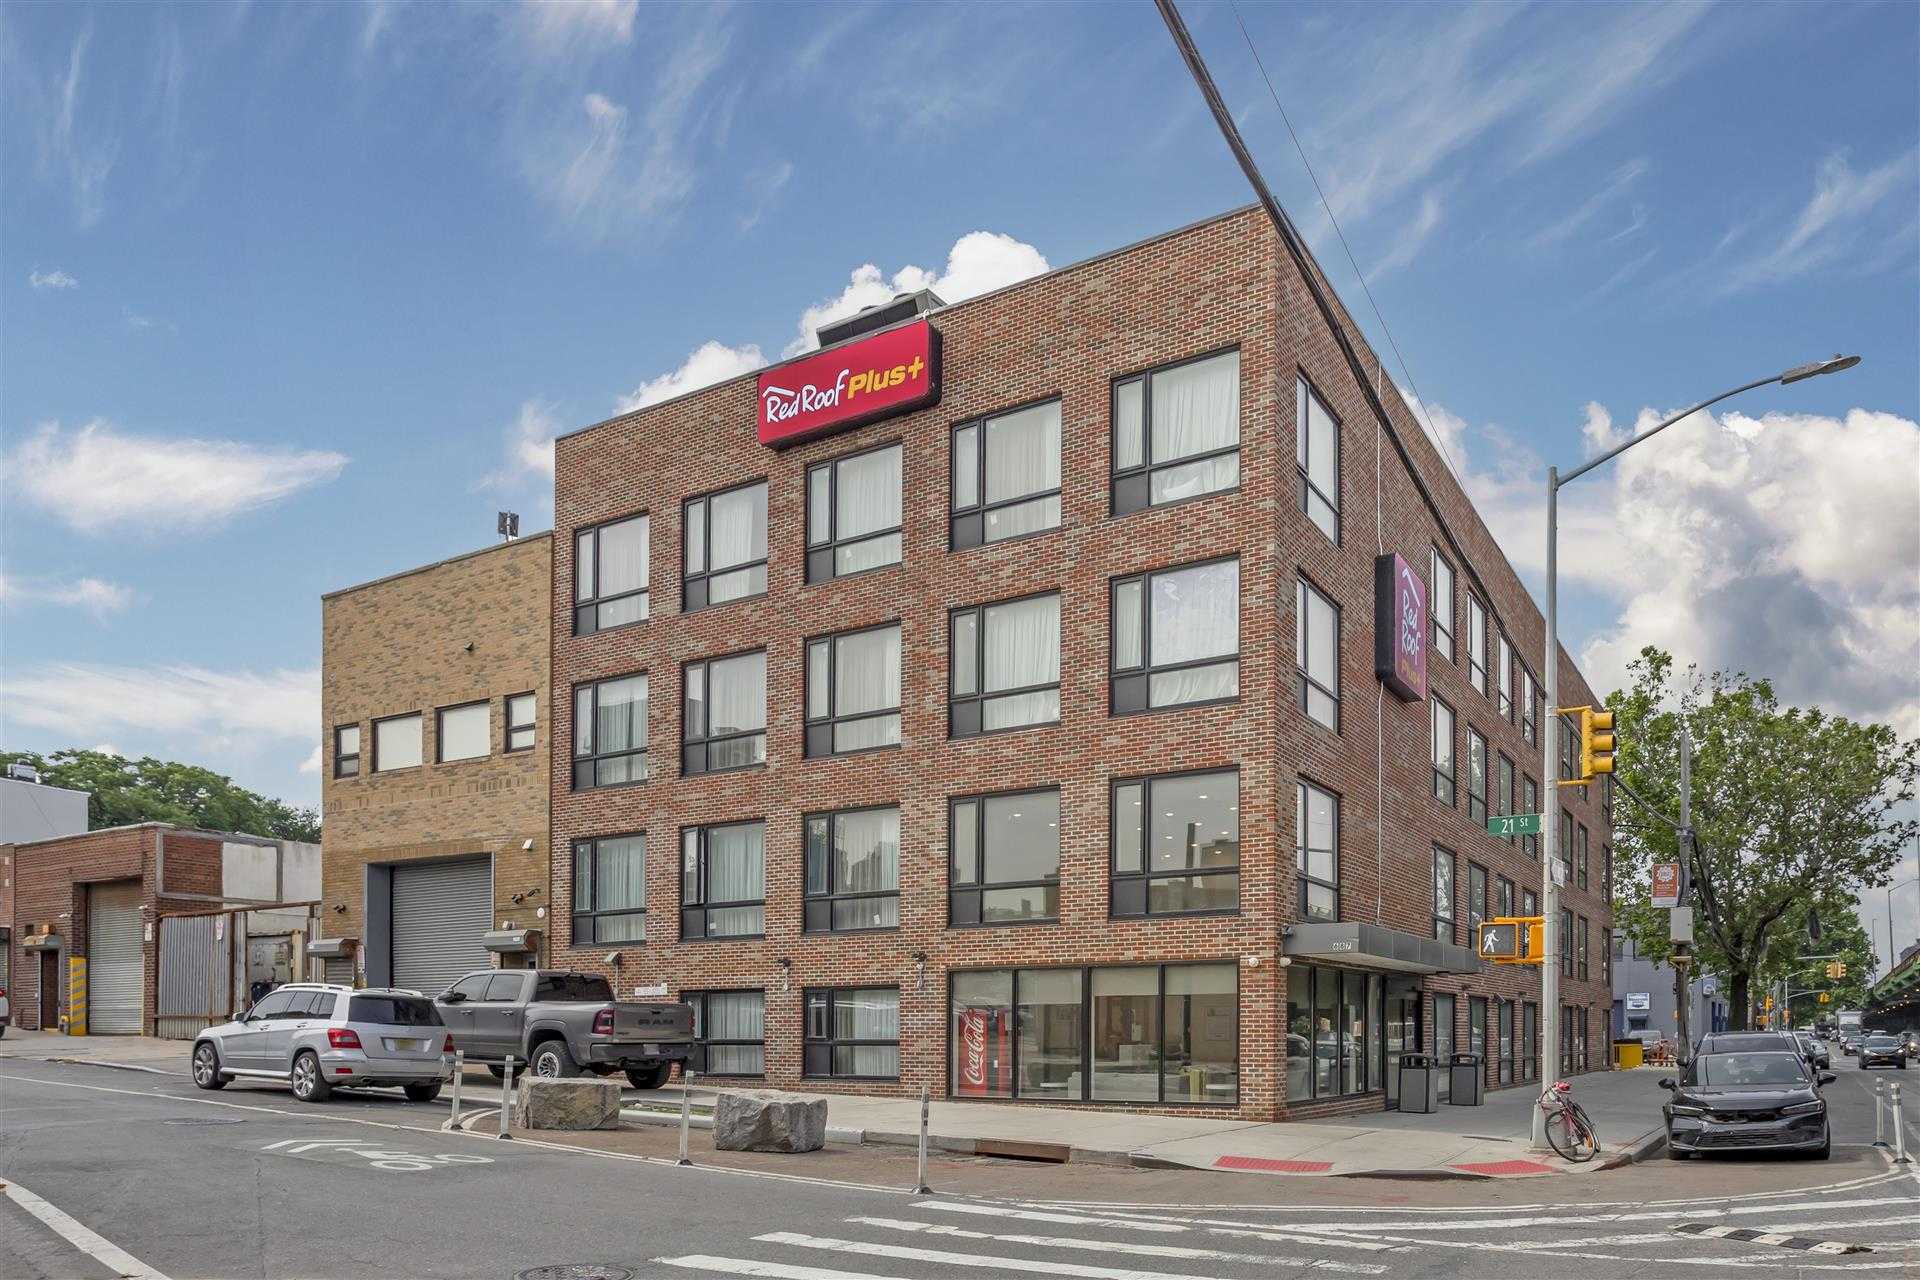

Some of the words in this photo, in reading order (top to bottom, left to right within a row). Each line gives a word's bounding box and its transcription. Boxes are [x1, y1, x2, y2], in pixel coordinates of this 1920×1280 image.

[1403, 589, 1418, 631] Red
[1402, 619, 1420, 665] Roof
[1501, 819, 1514, 833] 21
[1520, 817, 1528, 827] St
